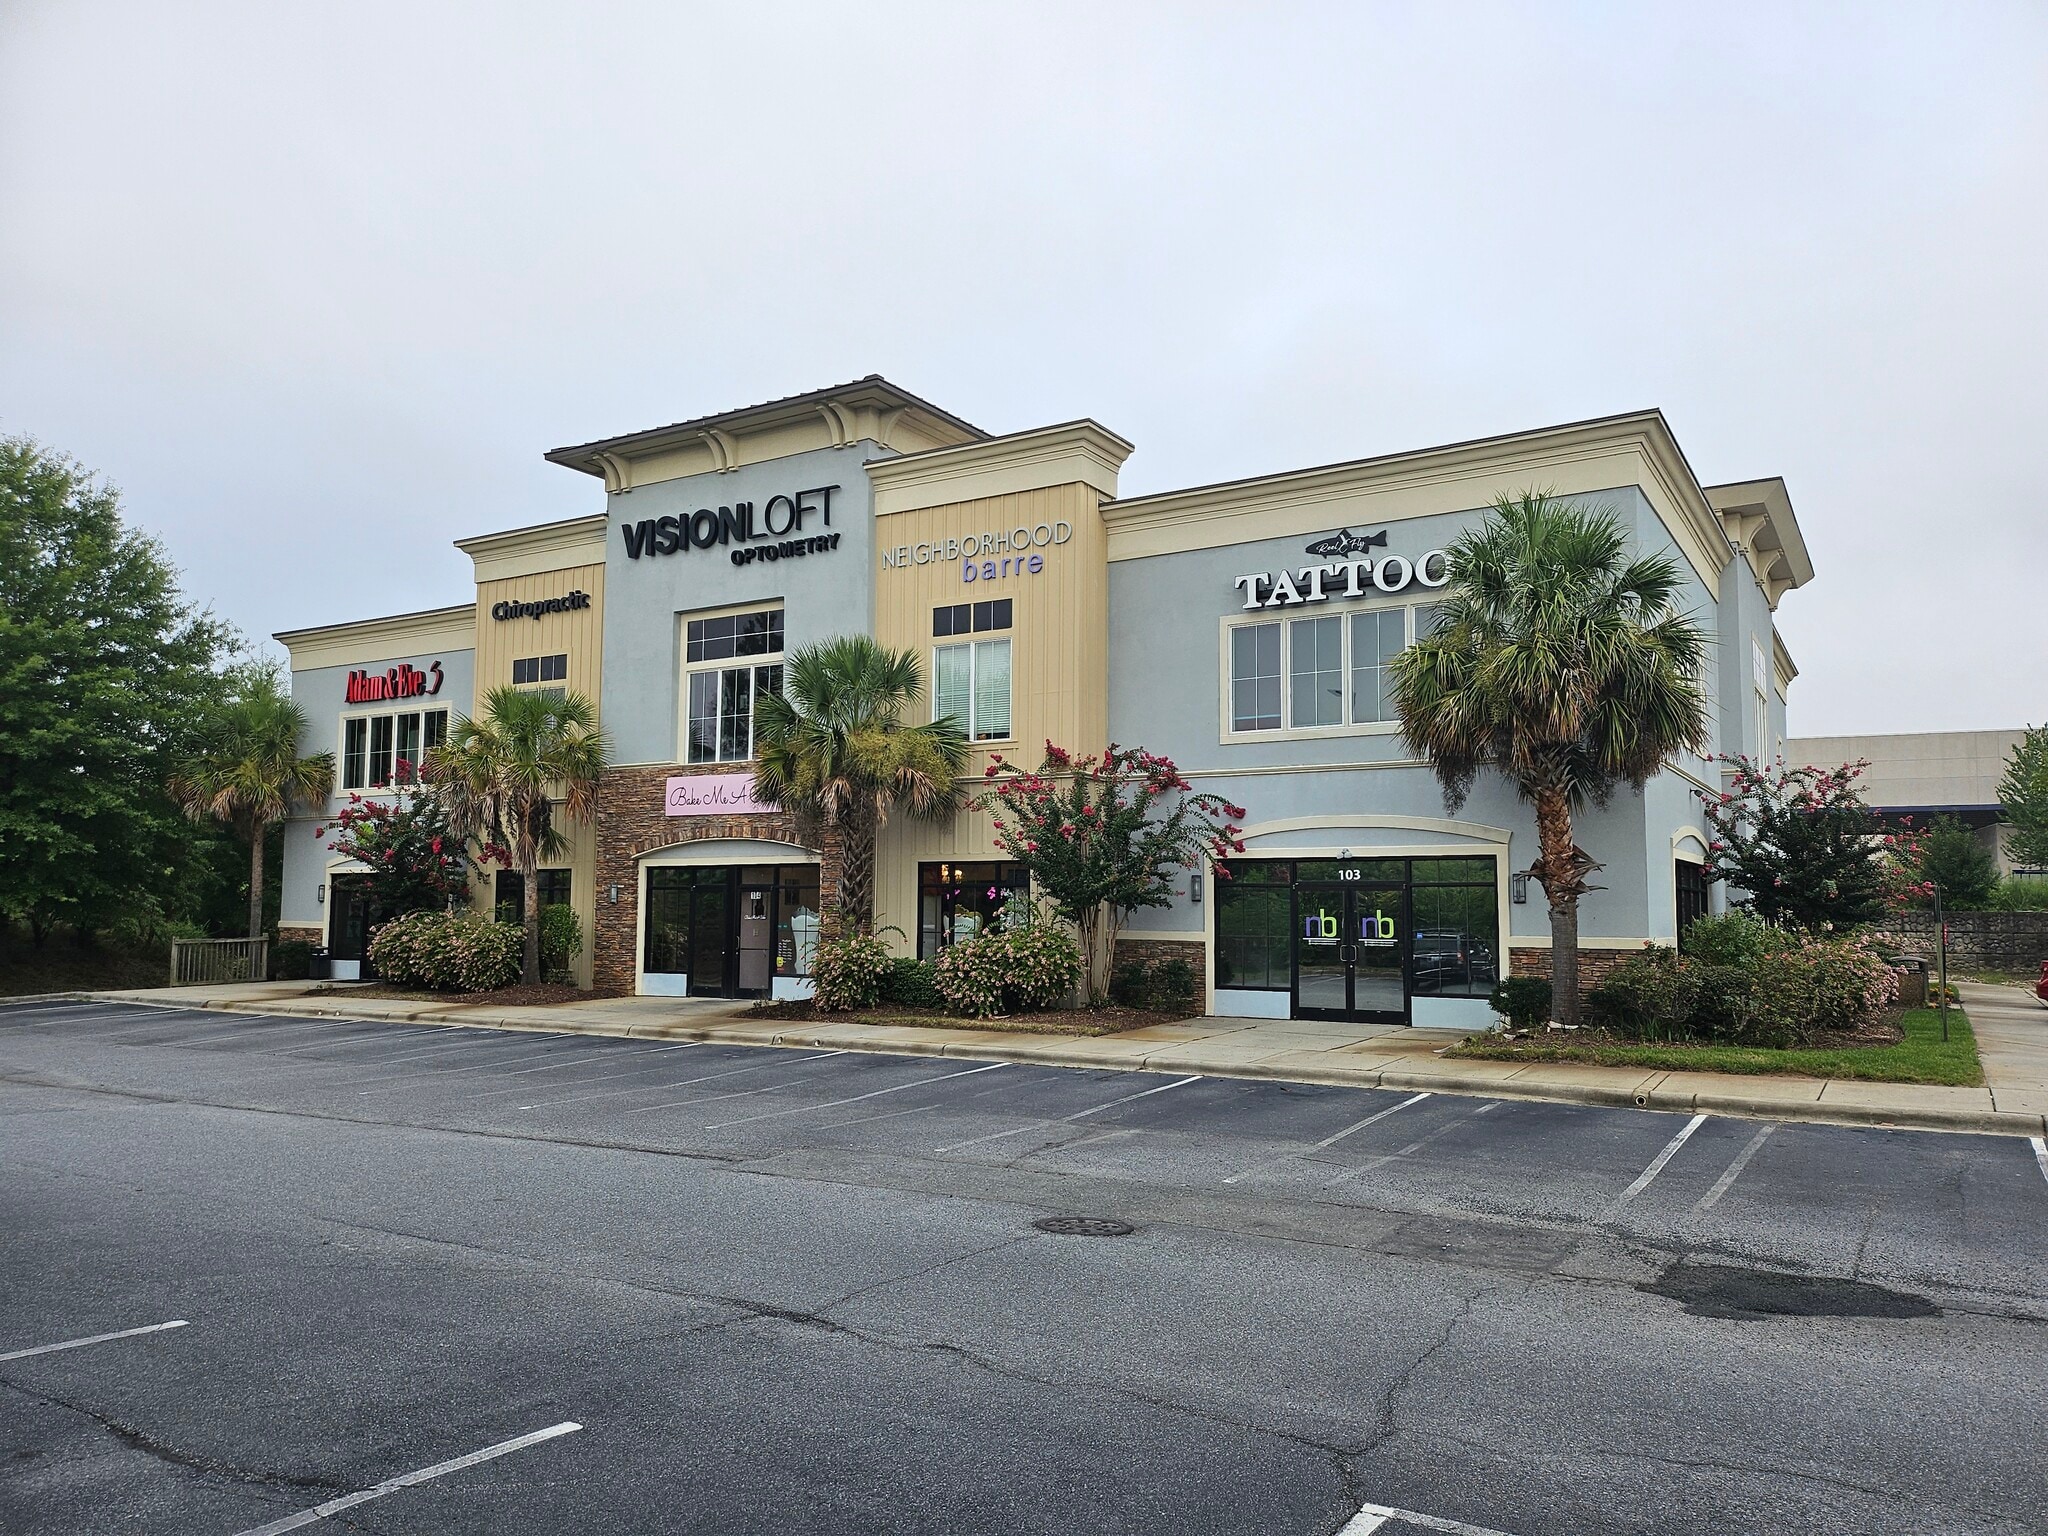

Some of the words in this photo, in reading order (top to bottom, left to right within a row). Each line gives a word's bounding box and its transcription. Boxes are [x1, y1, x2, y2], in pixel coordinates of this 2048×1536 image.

[621, 484, 841, 559] VISIONLOFT
[731, 532, 841, 566] OPTOMETRY
[882, 520, 1073, 570] NEIGHBORHOOD
[963, 553, 1044, 582] barre
[492, 590, 591, 621] Chiropractic
[670, 786, 701, 807] Bake
[1338, 869, 1361, 880] 103
[1305, 908, 1337, 938] nb
[1362, 909, 1395, 939] nb
